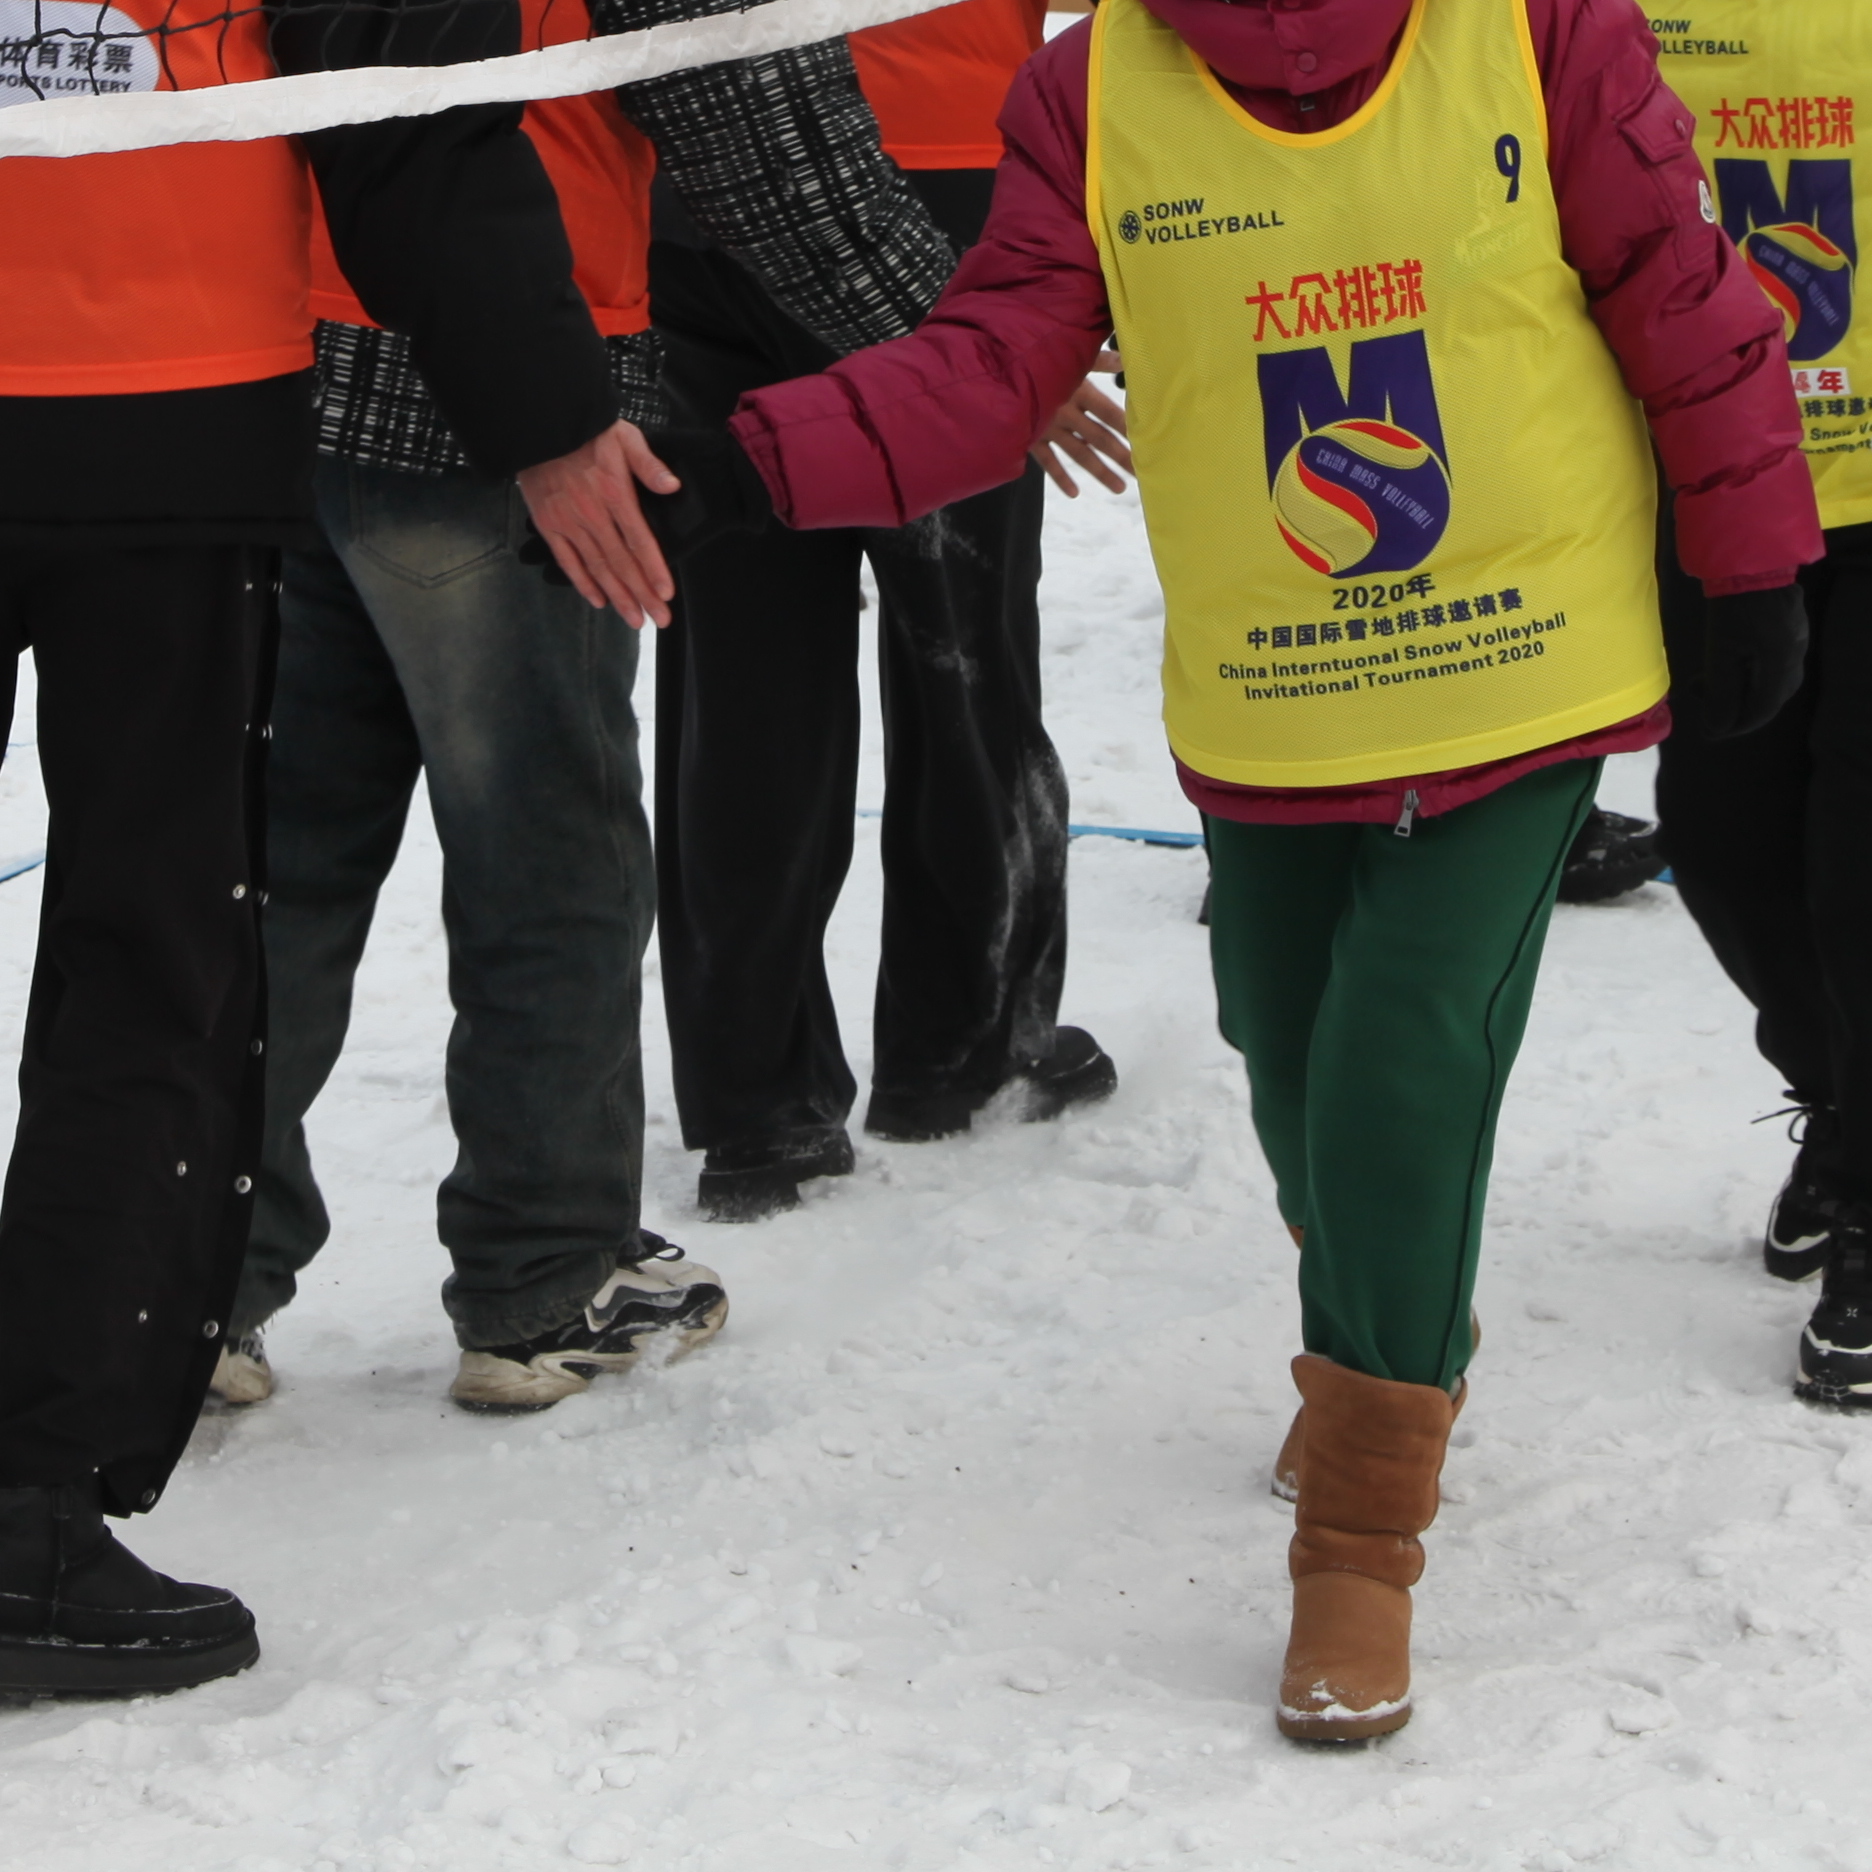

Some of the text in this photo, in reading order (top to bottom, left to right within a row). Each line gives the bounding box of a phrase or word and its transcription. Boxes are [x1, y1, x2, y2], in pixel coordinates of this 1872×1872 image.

[1647, 18, 1691, 33] ONW
[1661, 40, 1749, 55] LLEYBALL
[1712, 97, 1855, 148] 大众排球
[1494, 133, 1521, 203] 9
[1144, 198, 1204, 221] SONW
[1145, 210, 1285, 245] VOLLEYBALL
[1245, 259, 1426, 342] 大众排球
[1332, 573, 1436, 611] 2020年
[1247, 587, 1524, 651] 中国国际雪地排球邀请赛
[1218, 663, 1267, 680] China
[1404, 638, 1463, 661] Snow
[1466, 611, 1568, 649] Volleyball
[1244, 640, 1545, 701] Invitational Tournament 2020
